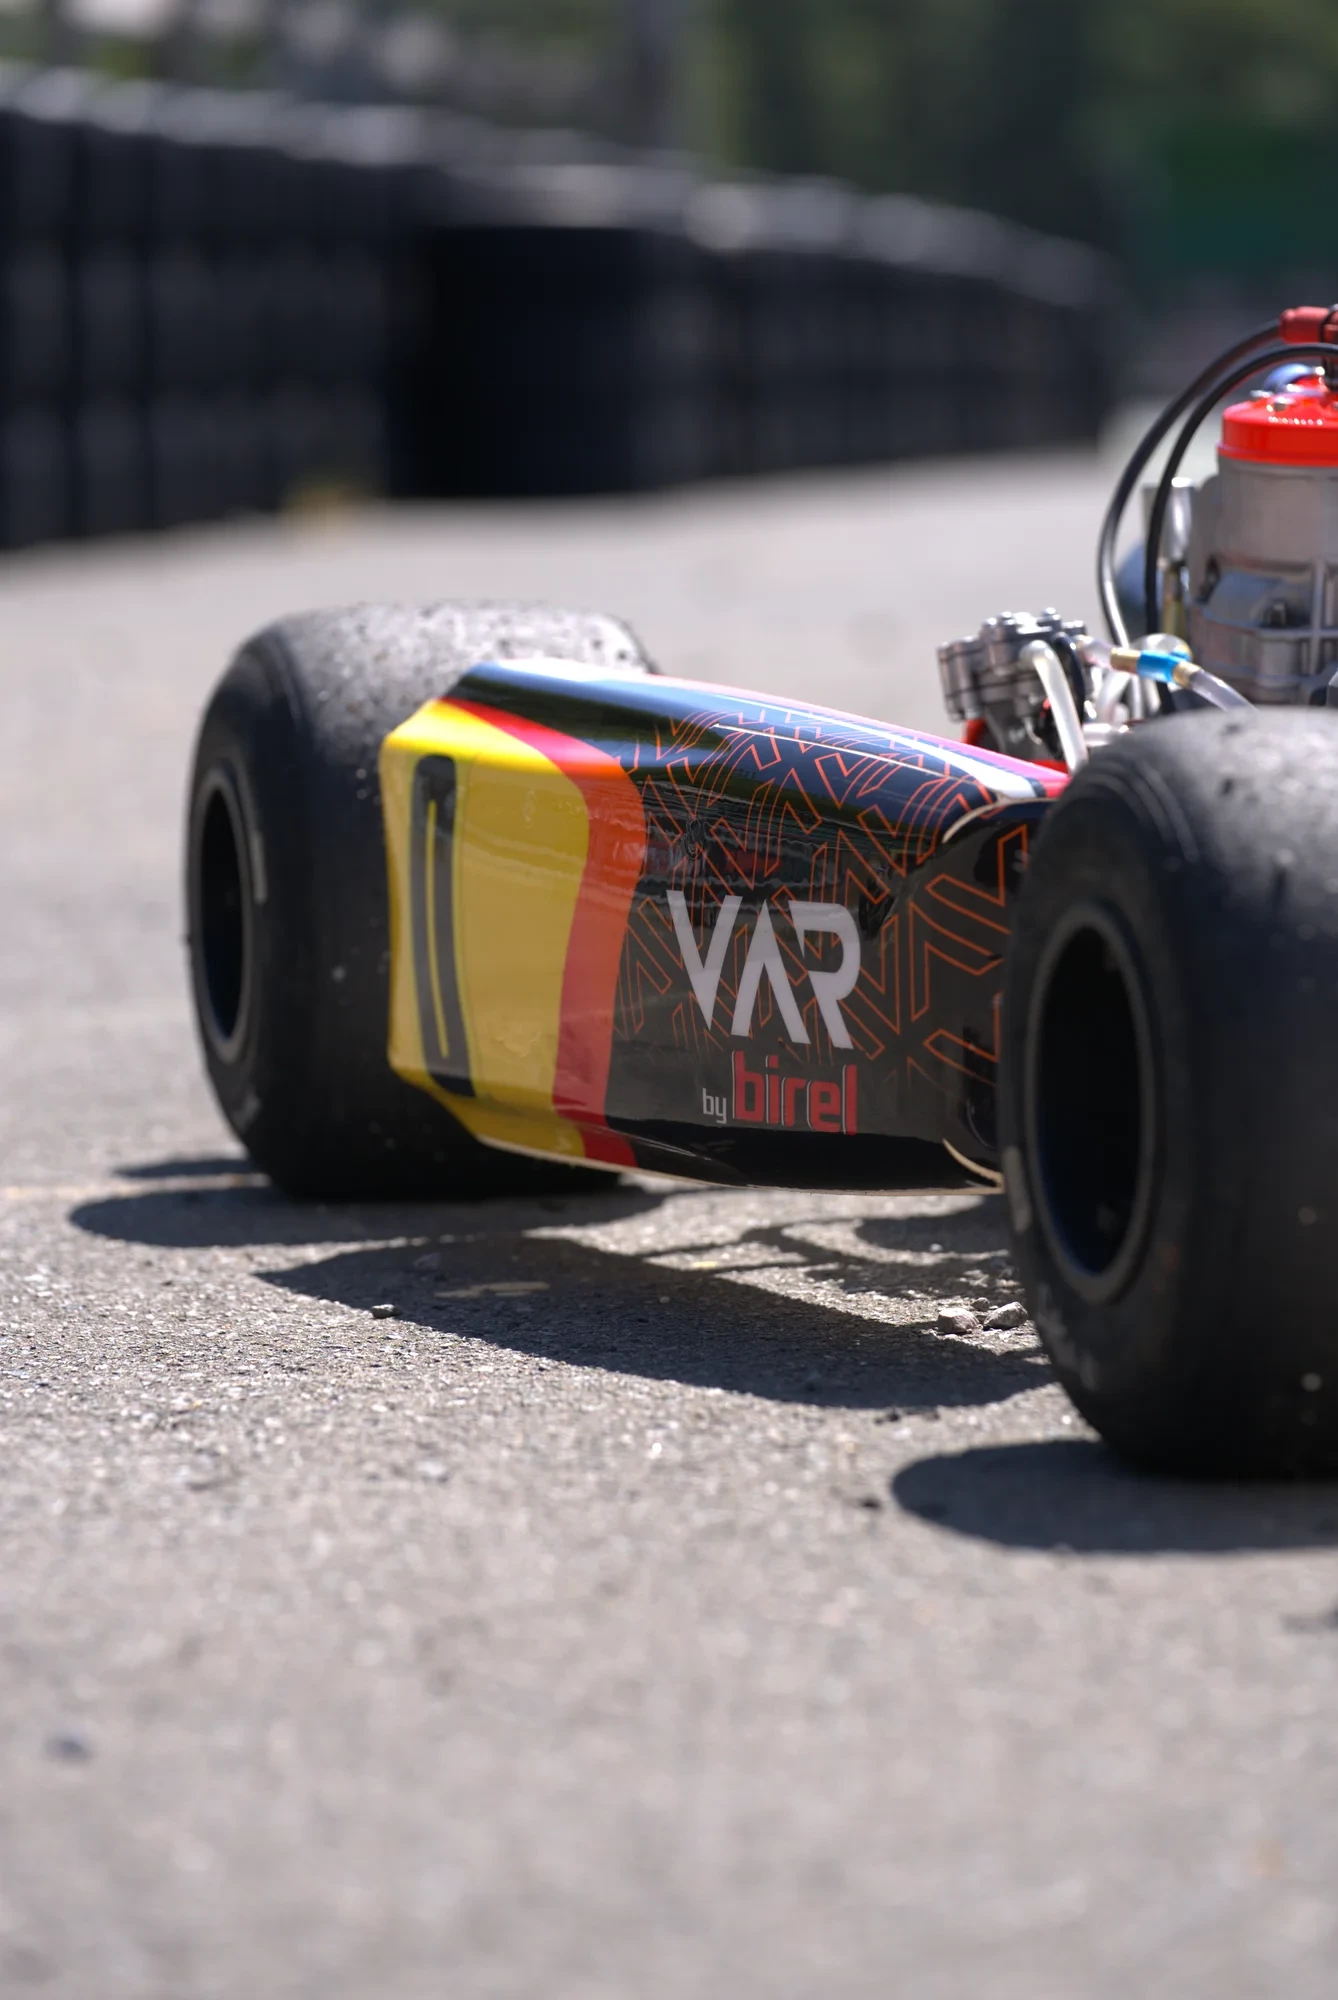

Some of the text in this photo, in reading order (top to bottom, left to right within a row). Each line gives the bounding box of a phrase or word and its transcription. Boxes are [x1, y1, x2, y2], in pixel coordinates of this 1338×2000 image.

[666, 889, 861, 1049] VAR
[702, 1050, 857, 1135] by birel
